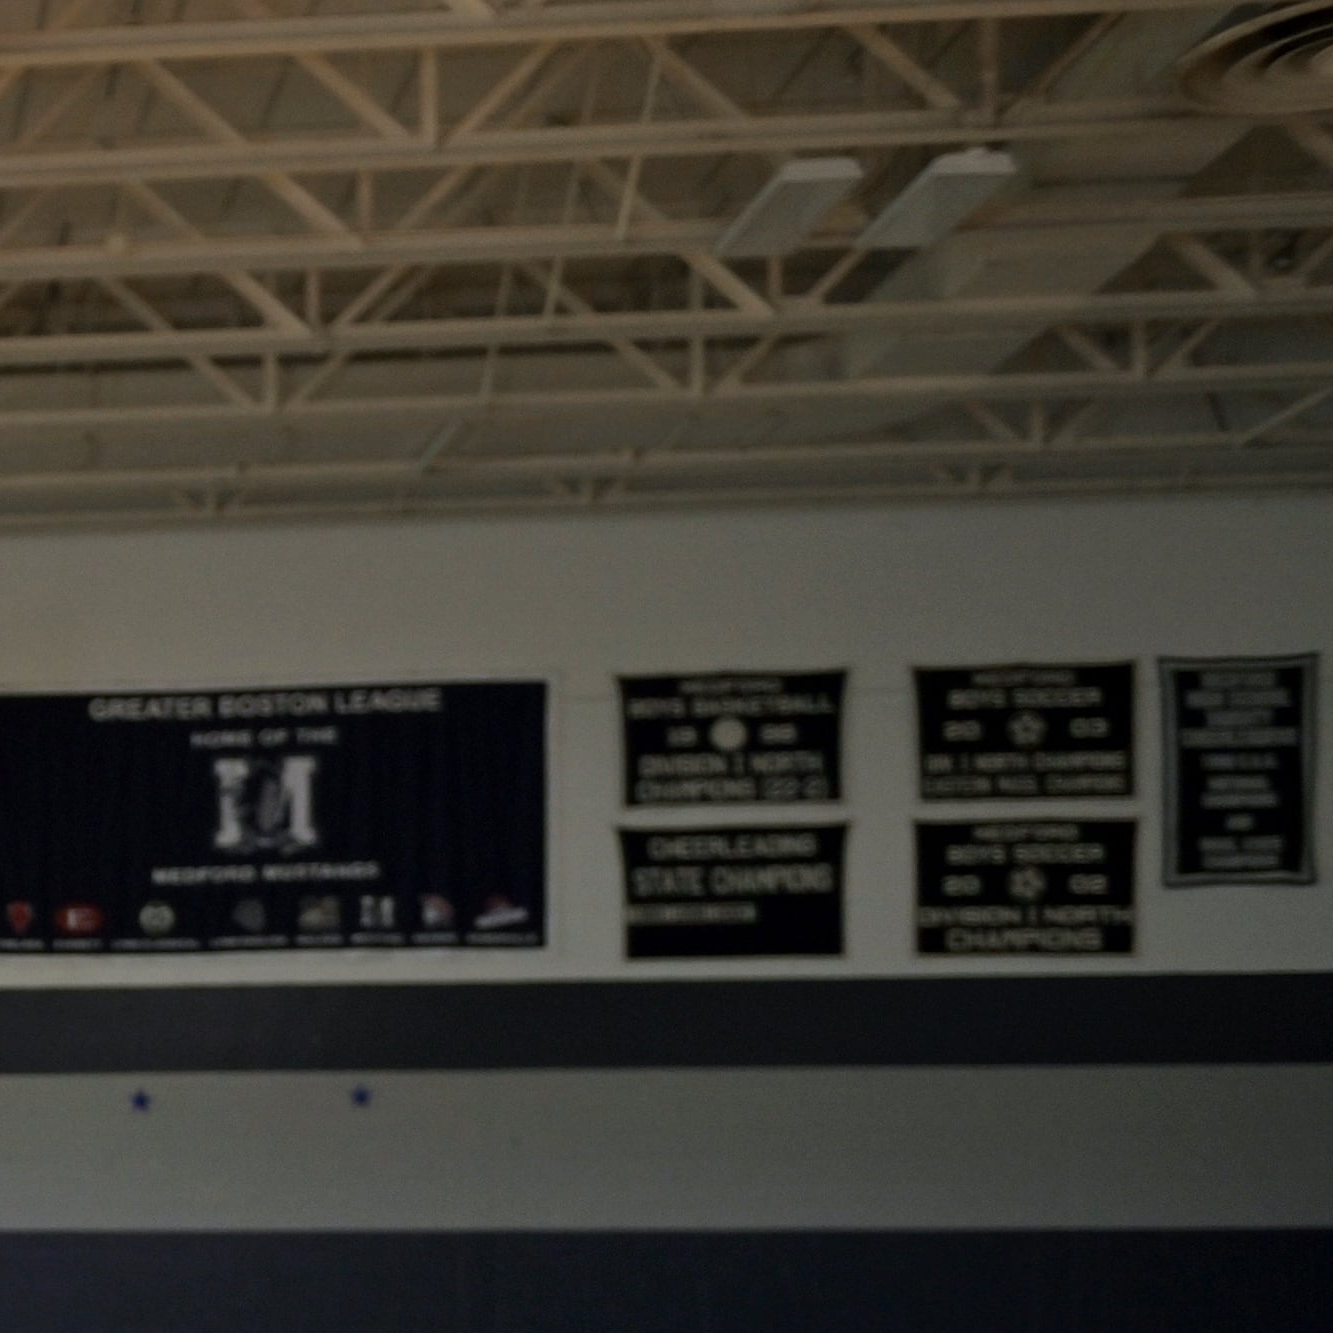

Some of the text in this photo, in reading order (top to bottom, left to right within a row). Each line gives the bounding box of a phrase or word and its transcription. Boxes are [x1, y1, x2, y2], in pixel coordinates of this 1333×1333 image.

[88, 687, 443, 722] GREATER BOSTON LEAGUE
[1012, 686, 1103, 707] SOCCER
[190, 725, 339, 750] HOME OF THE
[647, 833, 819, 862] CHEERLEADING
[1012, 843, 1106, 864] SOCCER
[151, 860, 381, 886] MEDFORD MUSTANGS
[634, 863, 832, 897] STATE CHAMPIONS
[945, 926, 1104, 952] CHAMPIONS
